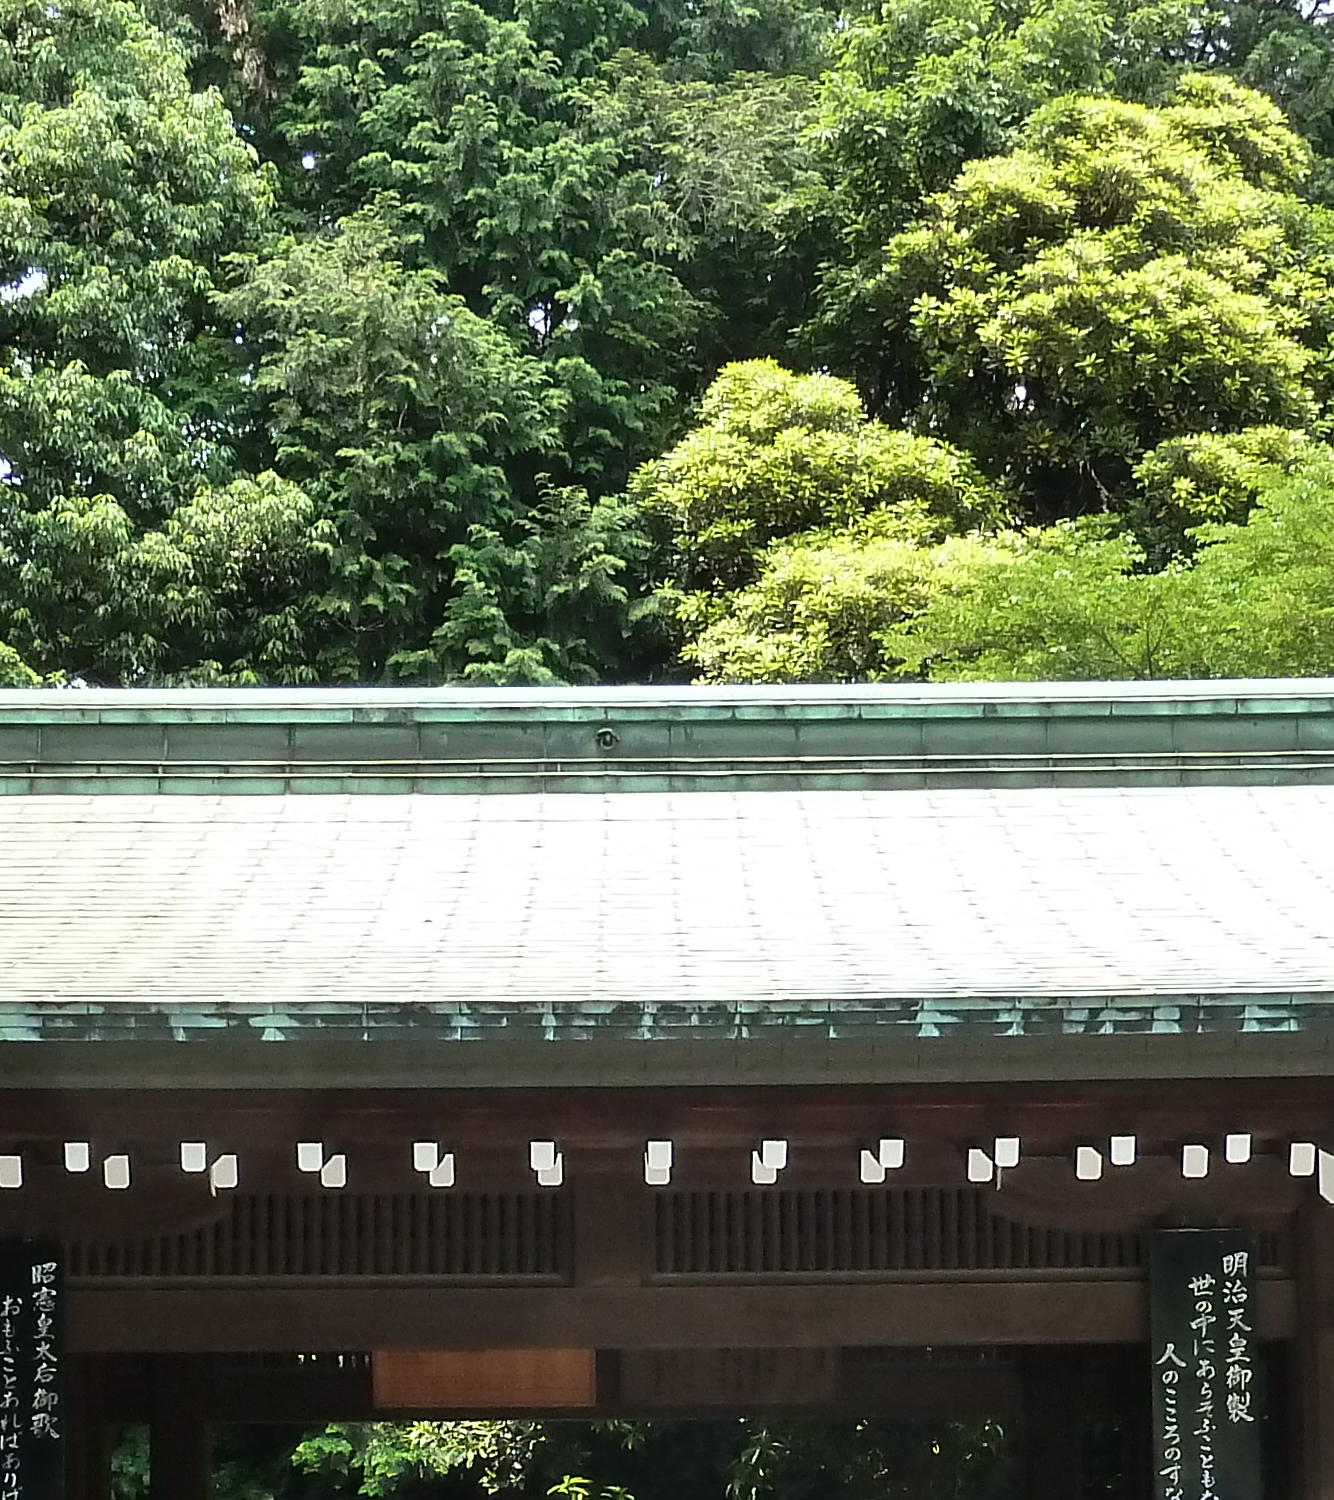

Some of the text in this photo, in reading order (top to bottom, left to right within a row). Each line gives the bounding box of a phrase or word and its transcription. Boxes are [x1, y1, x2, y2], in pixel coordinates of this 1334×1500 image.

[1222, 1251, 1254, 1423] 明治天皇御製
